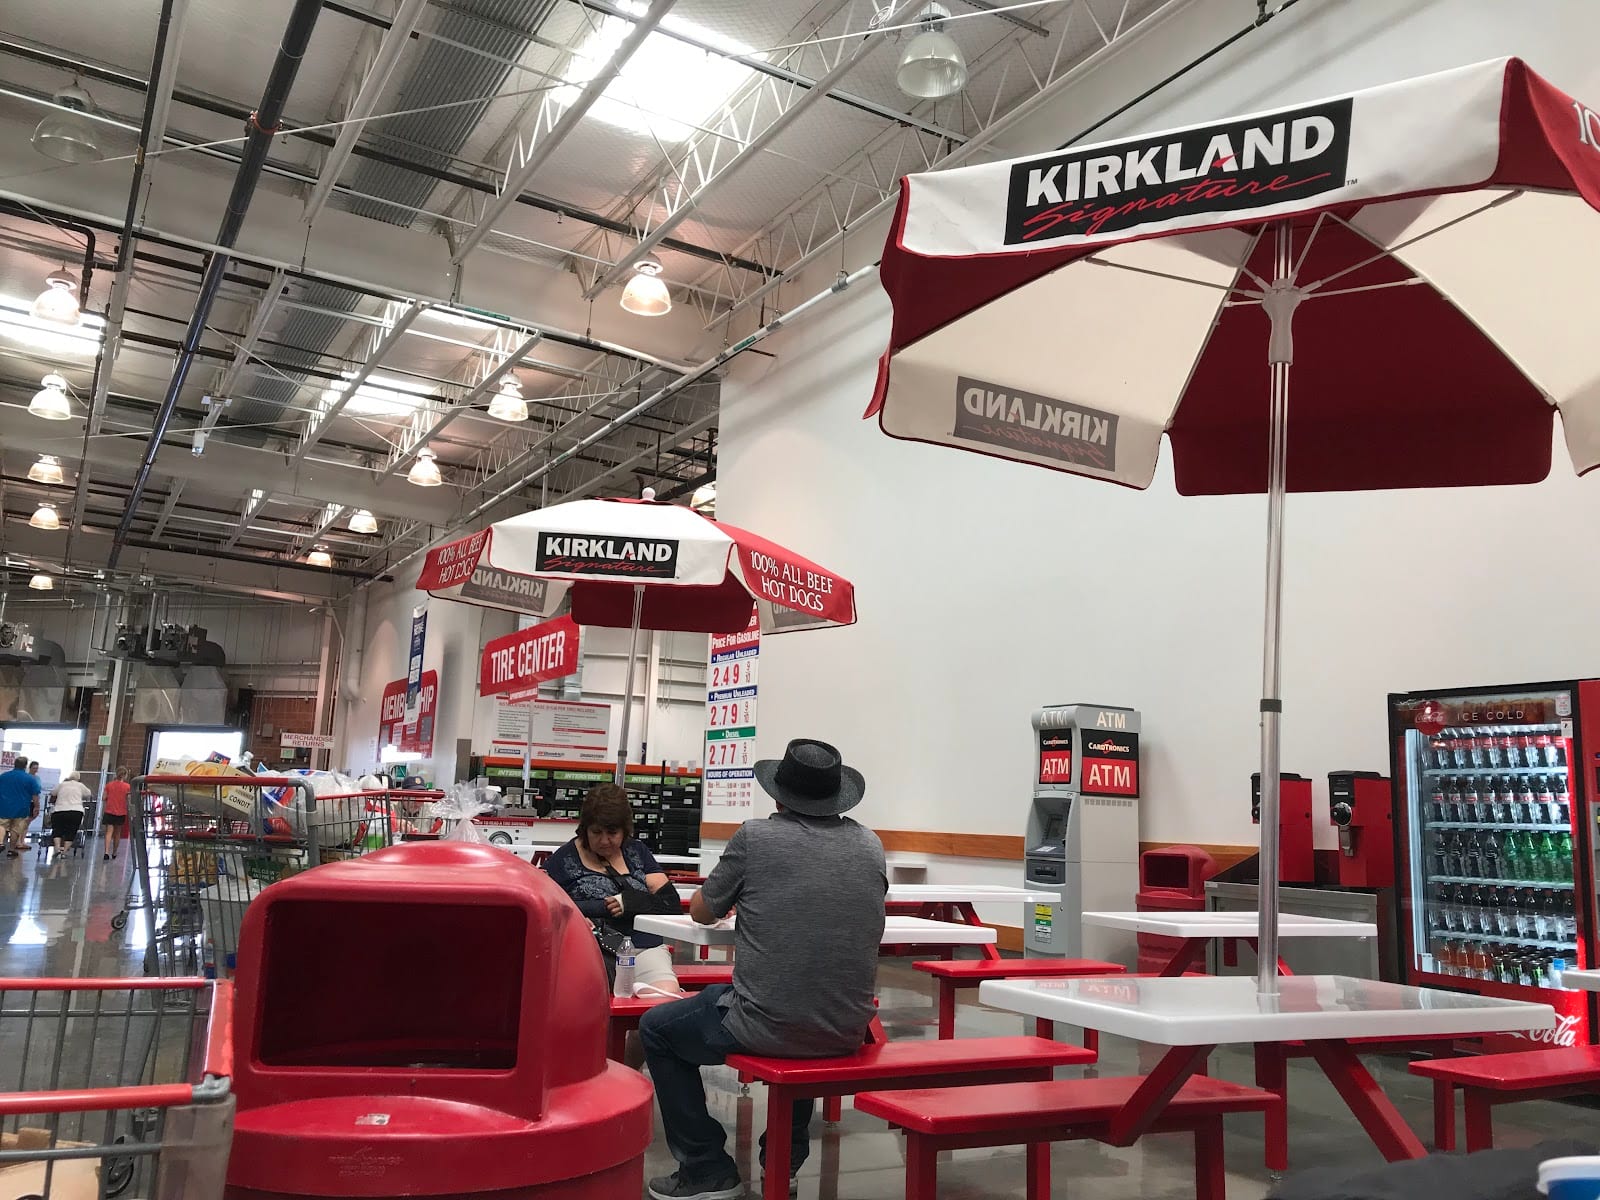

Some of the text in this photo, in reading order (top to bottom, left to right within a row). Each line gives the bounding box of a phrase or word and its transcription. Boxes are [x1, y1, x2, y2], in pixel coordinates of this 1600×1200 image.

[1025, 115, 1335, 207] KIRKLAND
[1022, 172, 1331, 239] Signature
[456, 540, 469, 560] ALL
[545, 537, 673, 562] KIRKLAND
[439, 564, 456, 583] HOT
[544, 555, 671, 573] Signature
[750, 550, 833, 594] 100% ALL BEEF
[762, 575, 785, 600] HOT
[789, 585, 824, 611] DOGS
[491, 630, 566, 684] TIRE CENTER
[712, 663, 740, 687] 2.49
[710, 703, 738, 726] 2.79
[1040, 710, 1068, 726] ATM
[1096, 711, 1126, 729] ATM
[1457, 711, 1525, 721] ICE COLD
[709, 743, 736, 765] 2.77
[1043, 758, 1069, 775] ATM
[1088, 763, 1131, 787] ATM
